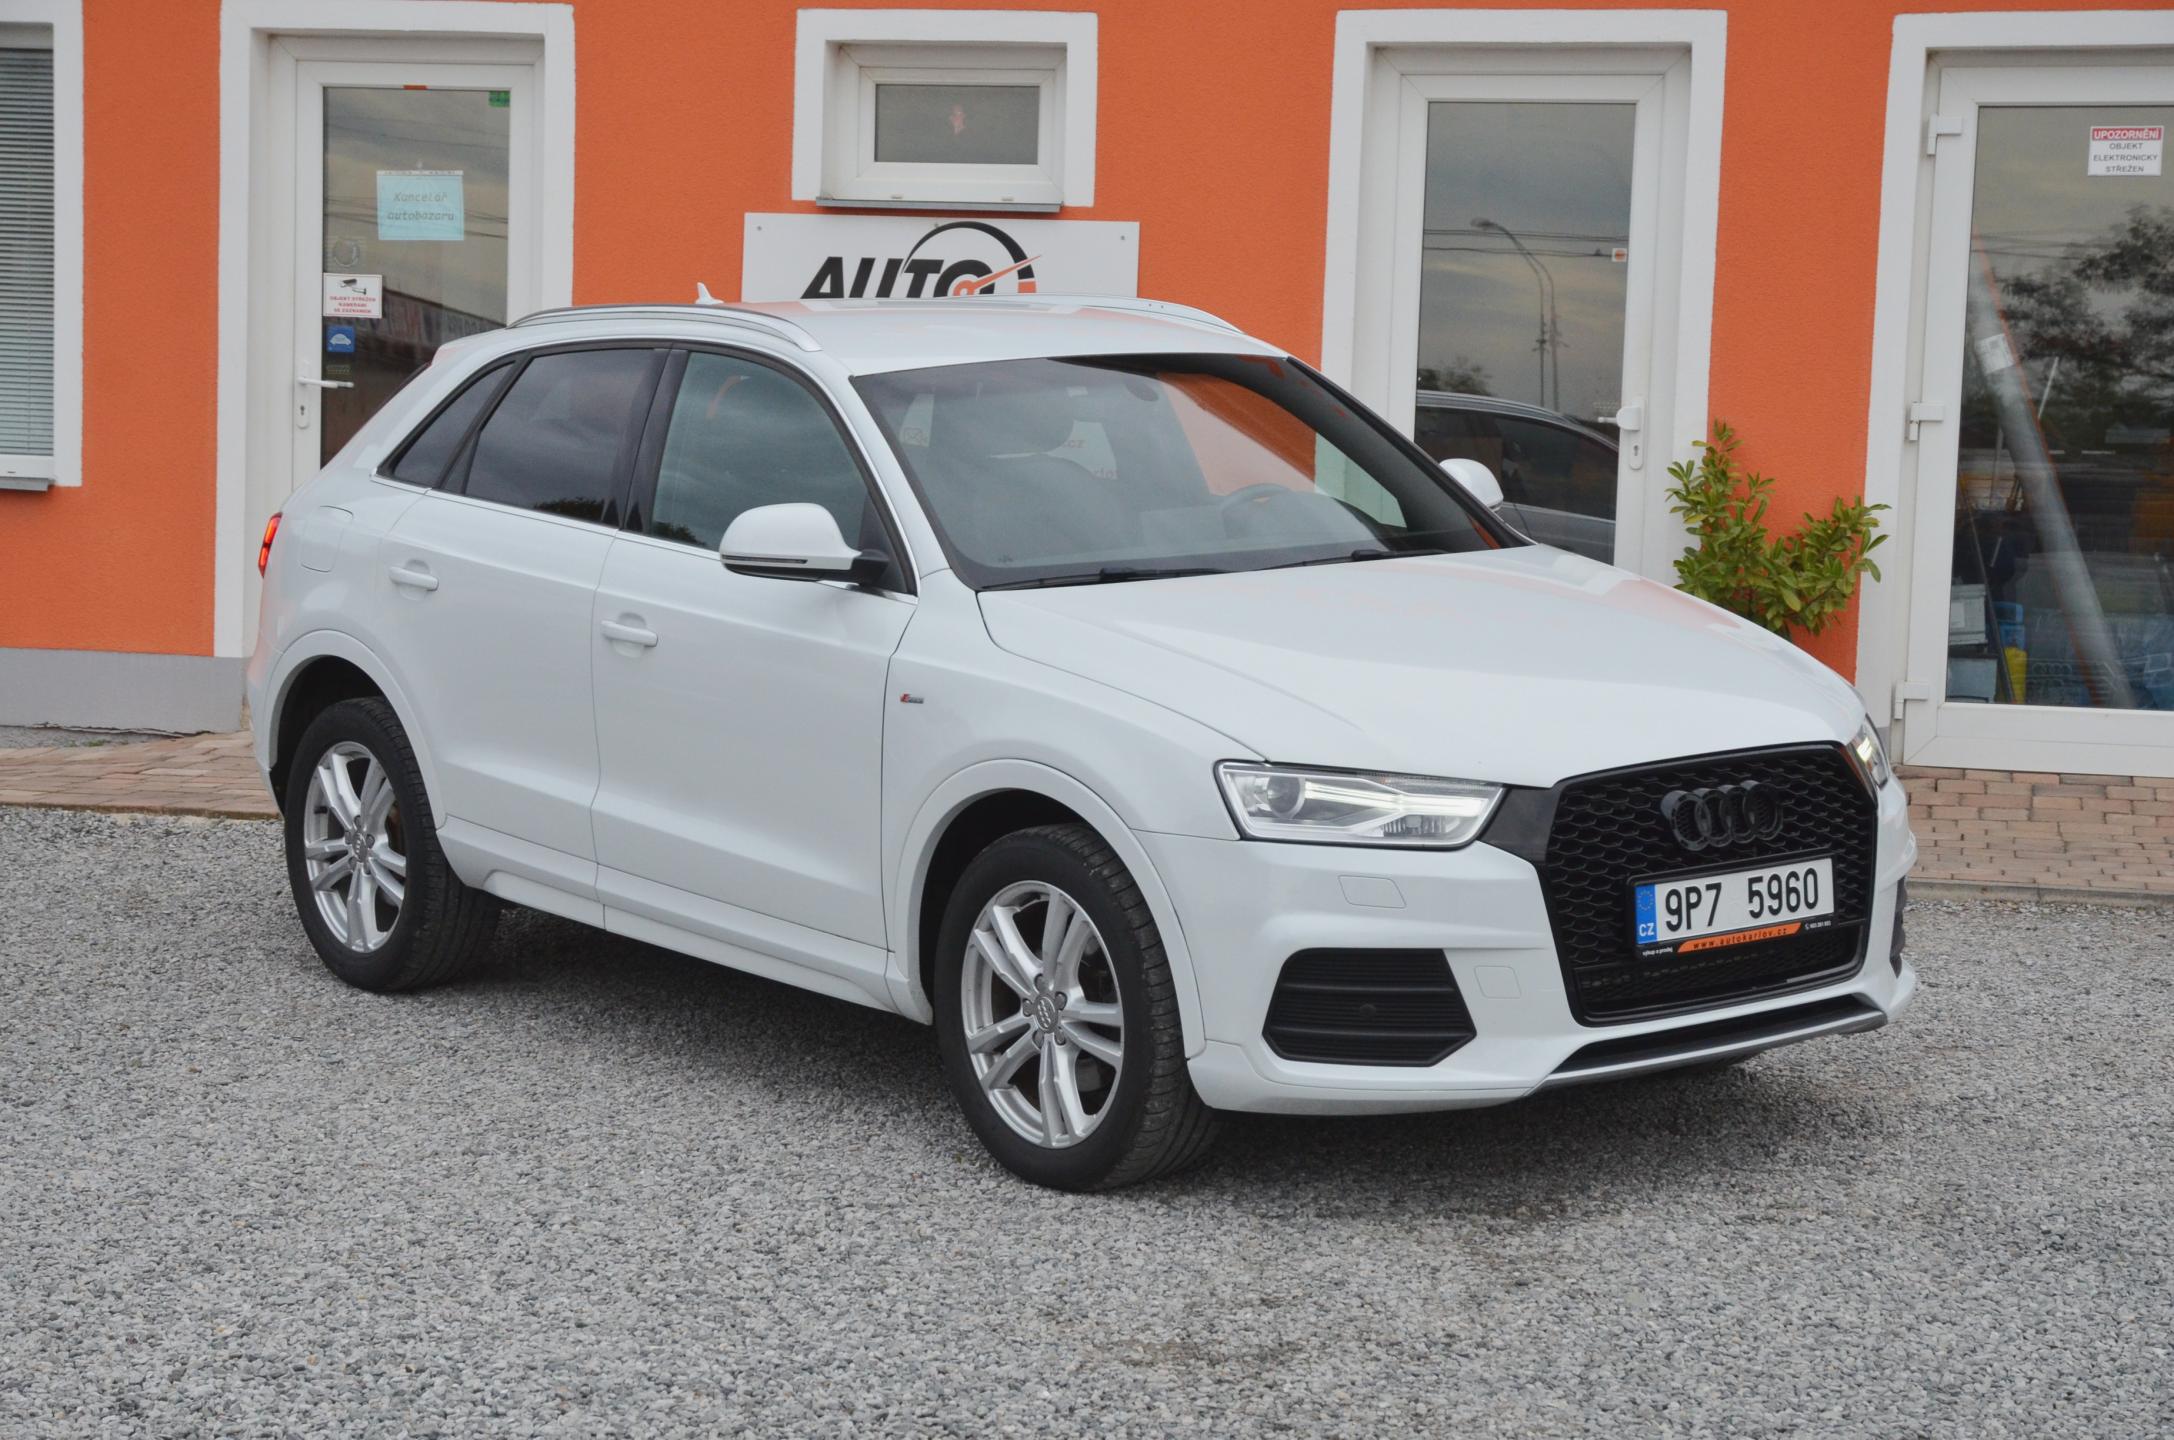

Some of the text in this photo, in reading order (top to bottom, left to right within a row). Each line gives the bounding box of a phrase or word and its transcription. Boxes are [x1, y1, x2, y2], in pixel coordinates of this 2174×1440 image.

[2109, 142, 2144, 150] OBJEKT
[2093, 154, 2158, 162] ELEKTRONICKY
[387, 210, 455, 221] autobazaru
[1639, 867, 1819, 937] CZ 9P7 5960
[1692, 927, 1788, 950] www.autokarlov.cz
